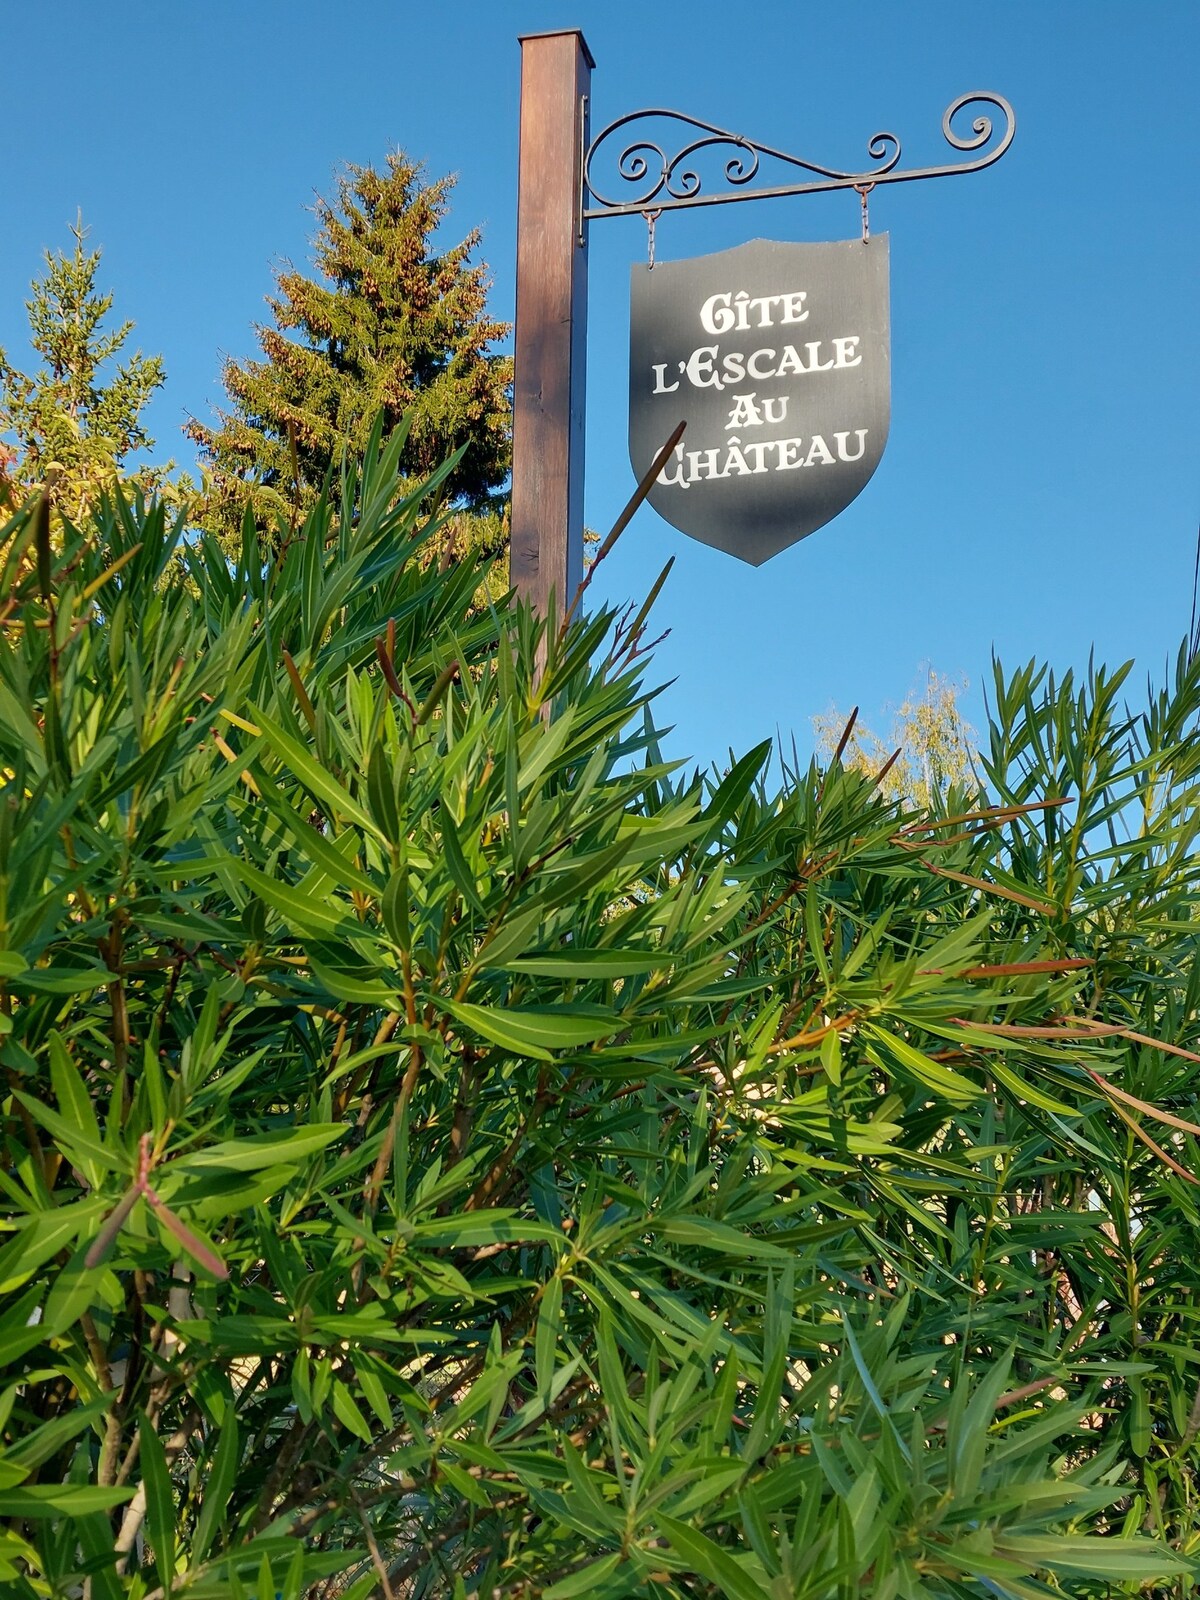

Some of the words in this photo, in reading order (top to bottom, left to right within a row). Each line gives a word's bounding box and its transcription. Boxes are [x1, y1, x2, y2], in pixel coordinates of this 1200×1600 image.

[700, 290, 809, 334] GÎTE
[651, 336, 863, 394] L'ESCALE
[724, 392, 790, 430] AU
[651, 428, 869, 489] CHÂTEAU
